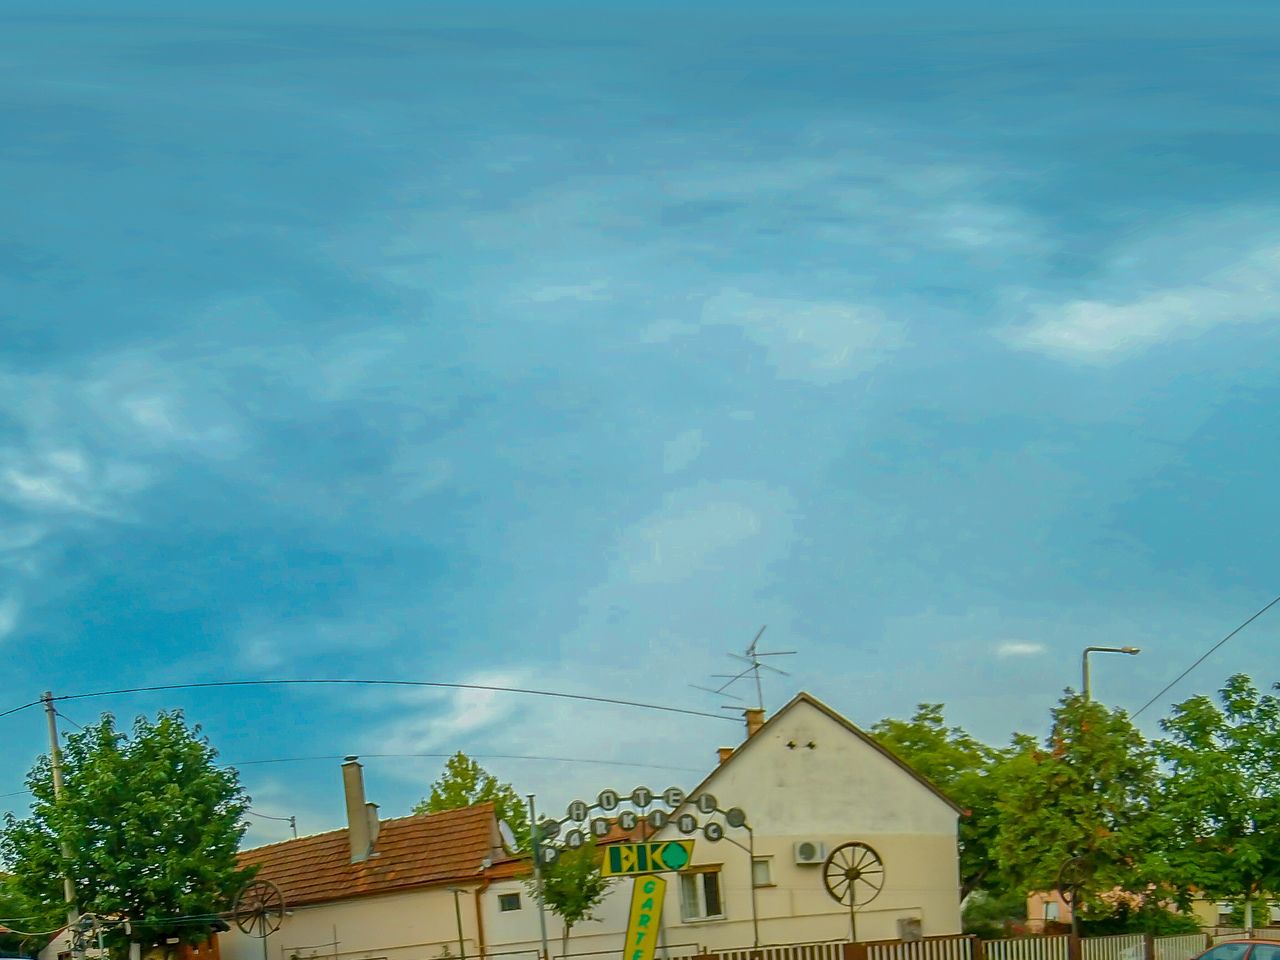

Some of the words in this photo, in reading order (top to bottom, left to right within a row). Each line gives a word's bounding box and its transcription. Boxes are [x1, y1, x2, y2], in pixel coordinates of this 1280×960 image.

[572, 789, 714, 822] HOTEL
[544, 811, 721, 864] PARKING
[608, 840, 690, 874] EKO
